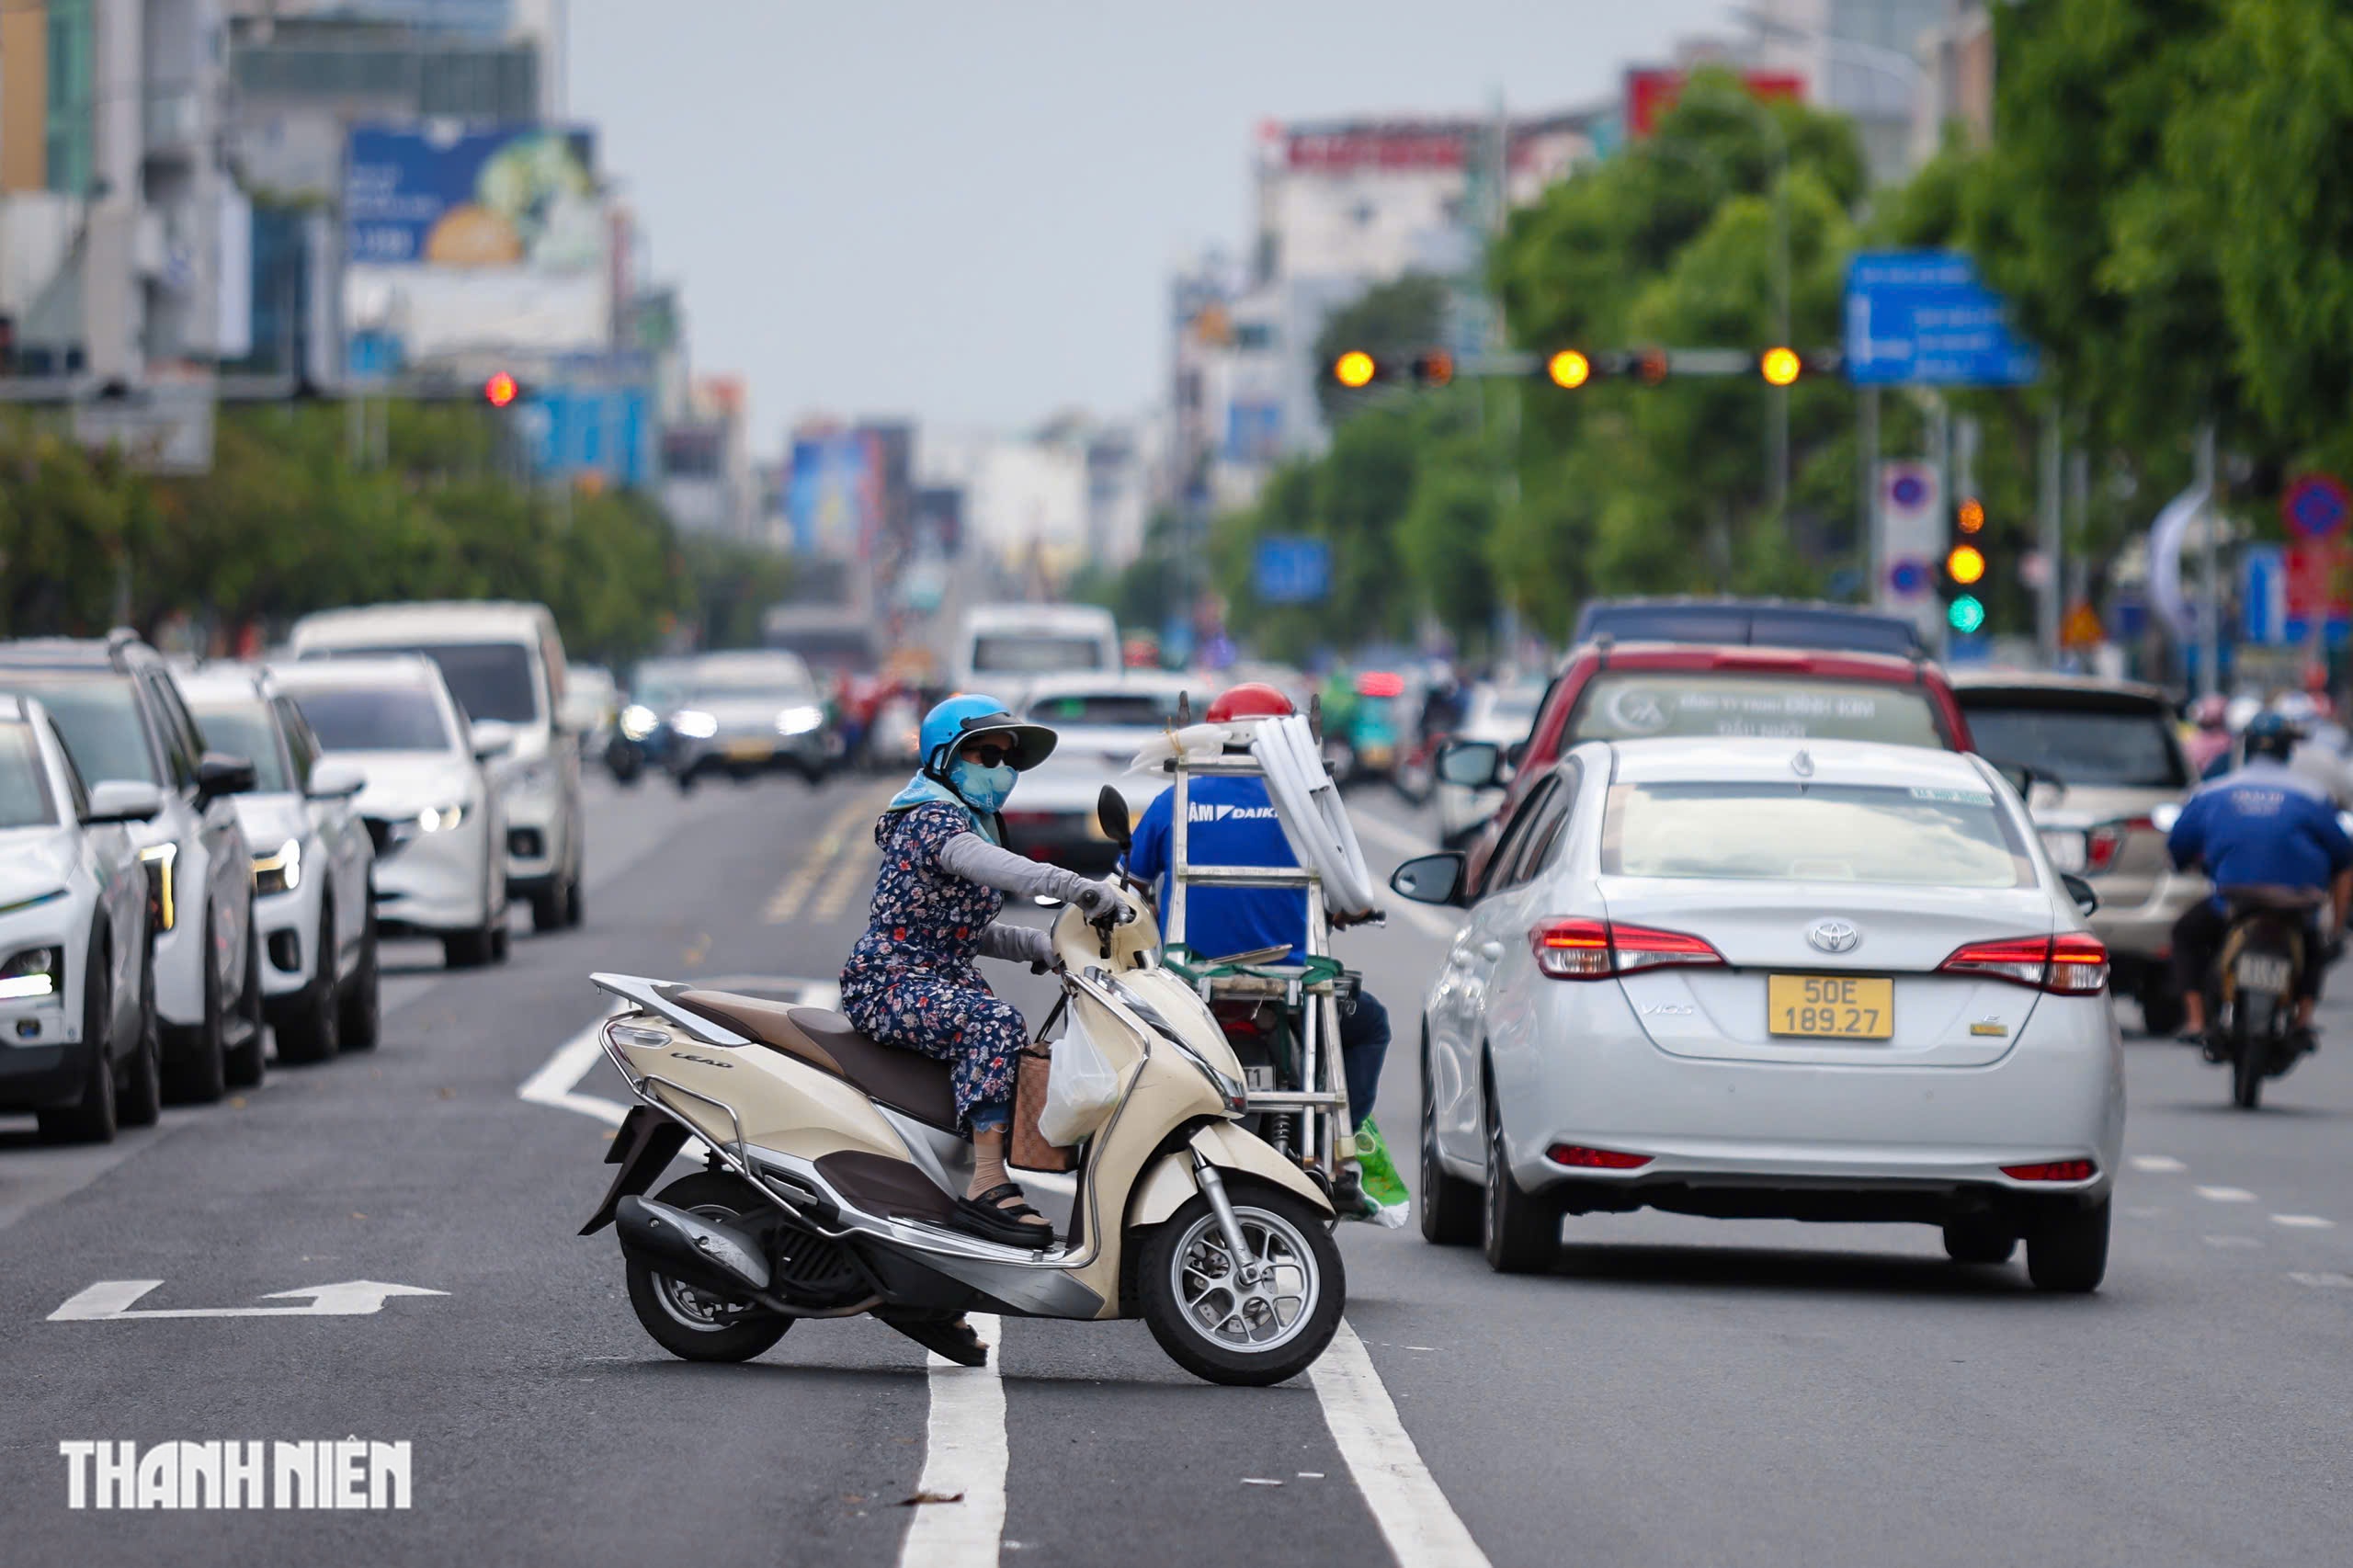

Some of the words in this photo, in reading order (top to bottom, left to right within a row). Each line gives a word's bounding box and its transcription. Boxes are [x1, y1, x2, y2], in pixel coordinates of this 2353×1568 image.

[1188, 801, 1213, 823] ÂM
[1231, 807, 1279, 820] DAIK
[1803, 978, 1858, 1005] 50E
[1786, 1006, 1879, 1033] 189.27
[670, 1051, 734, 1068] LEAD
[1244, 1067, 1261, 1088] T1
